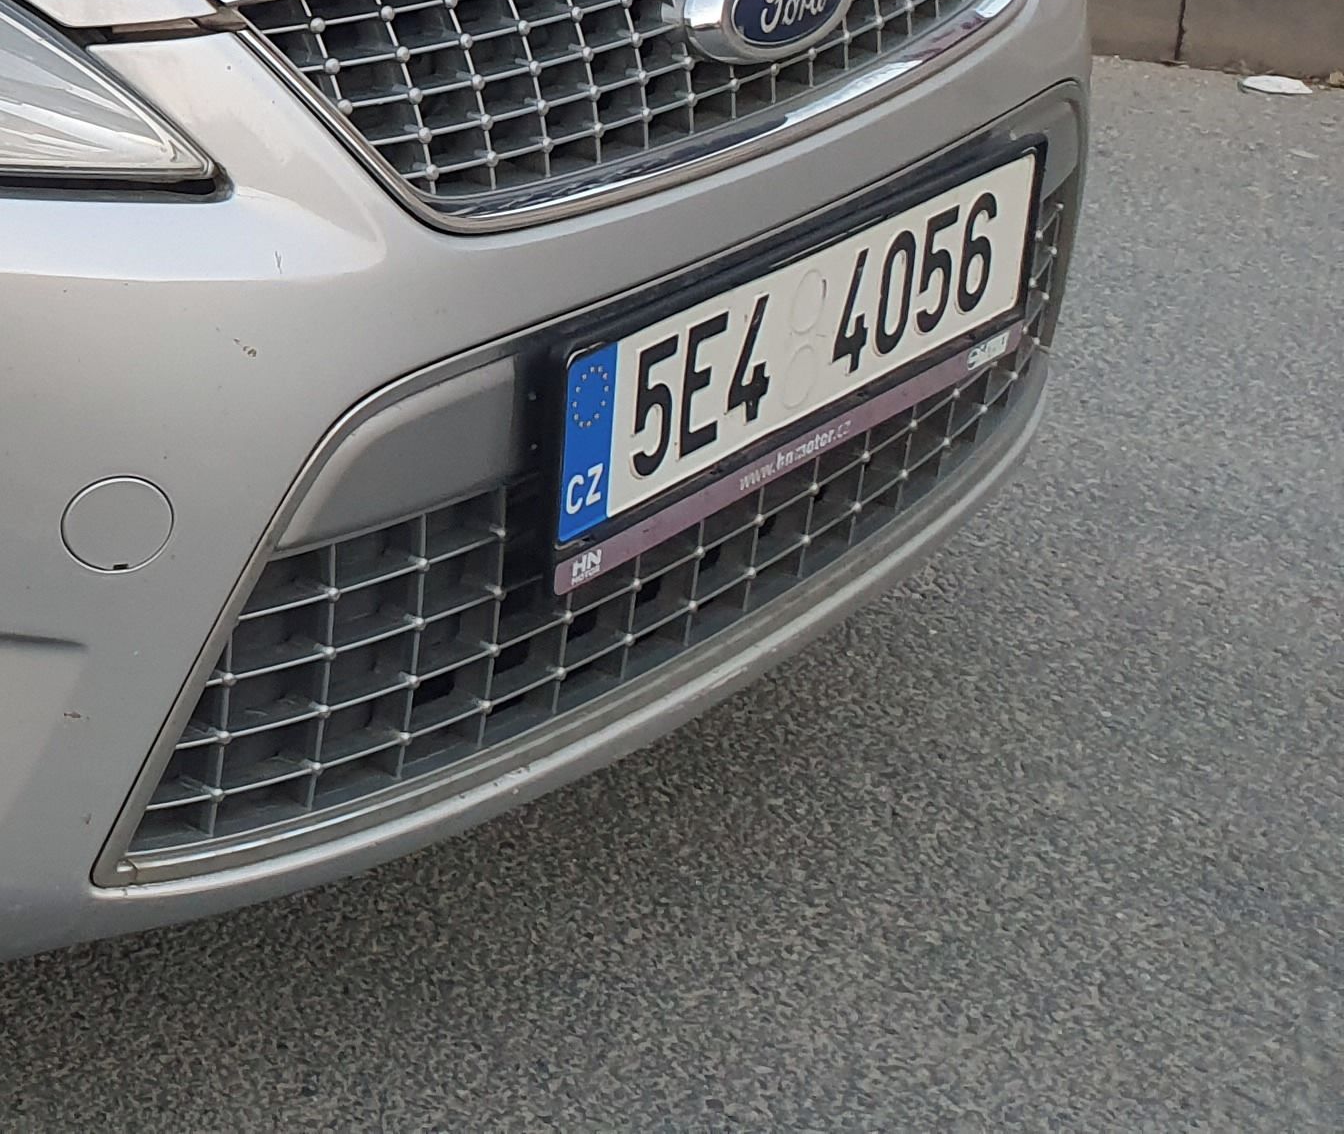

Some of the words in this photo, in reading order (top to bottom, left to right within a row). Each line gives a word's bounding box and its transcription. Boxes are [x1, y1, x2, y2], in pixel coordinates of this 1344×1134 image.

[631, 293, 770, 477] 5E4
[832, 192, 998, 374] 4056
[565, 463, 604, 515] CZ
[572, 549, 602, 577] HN
